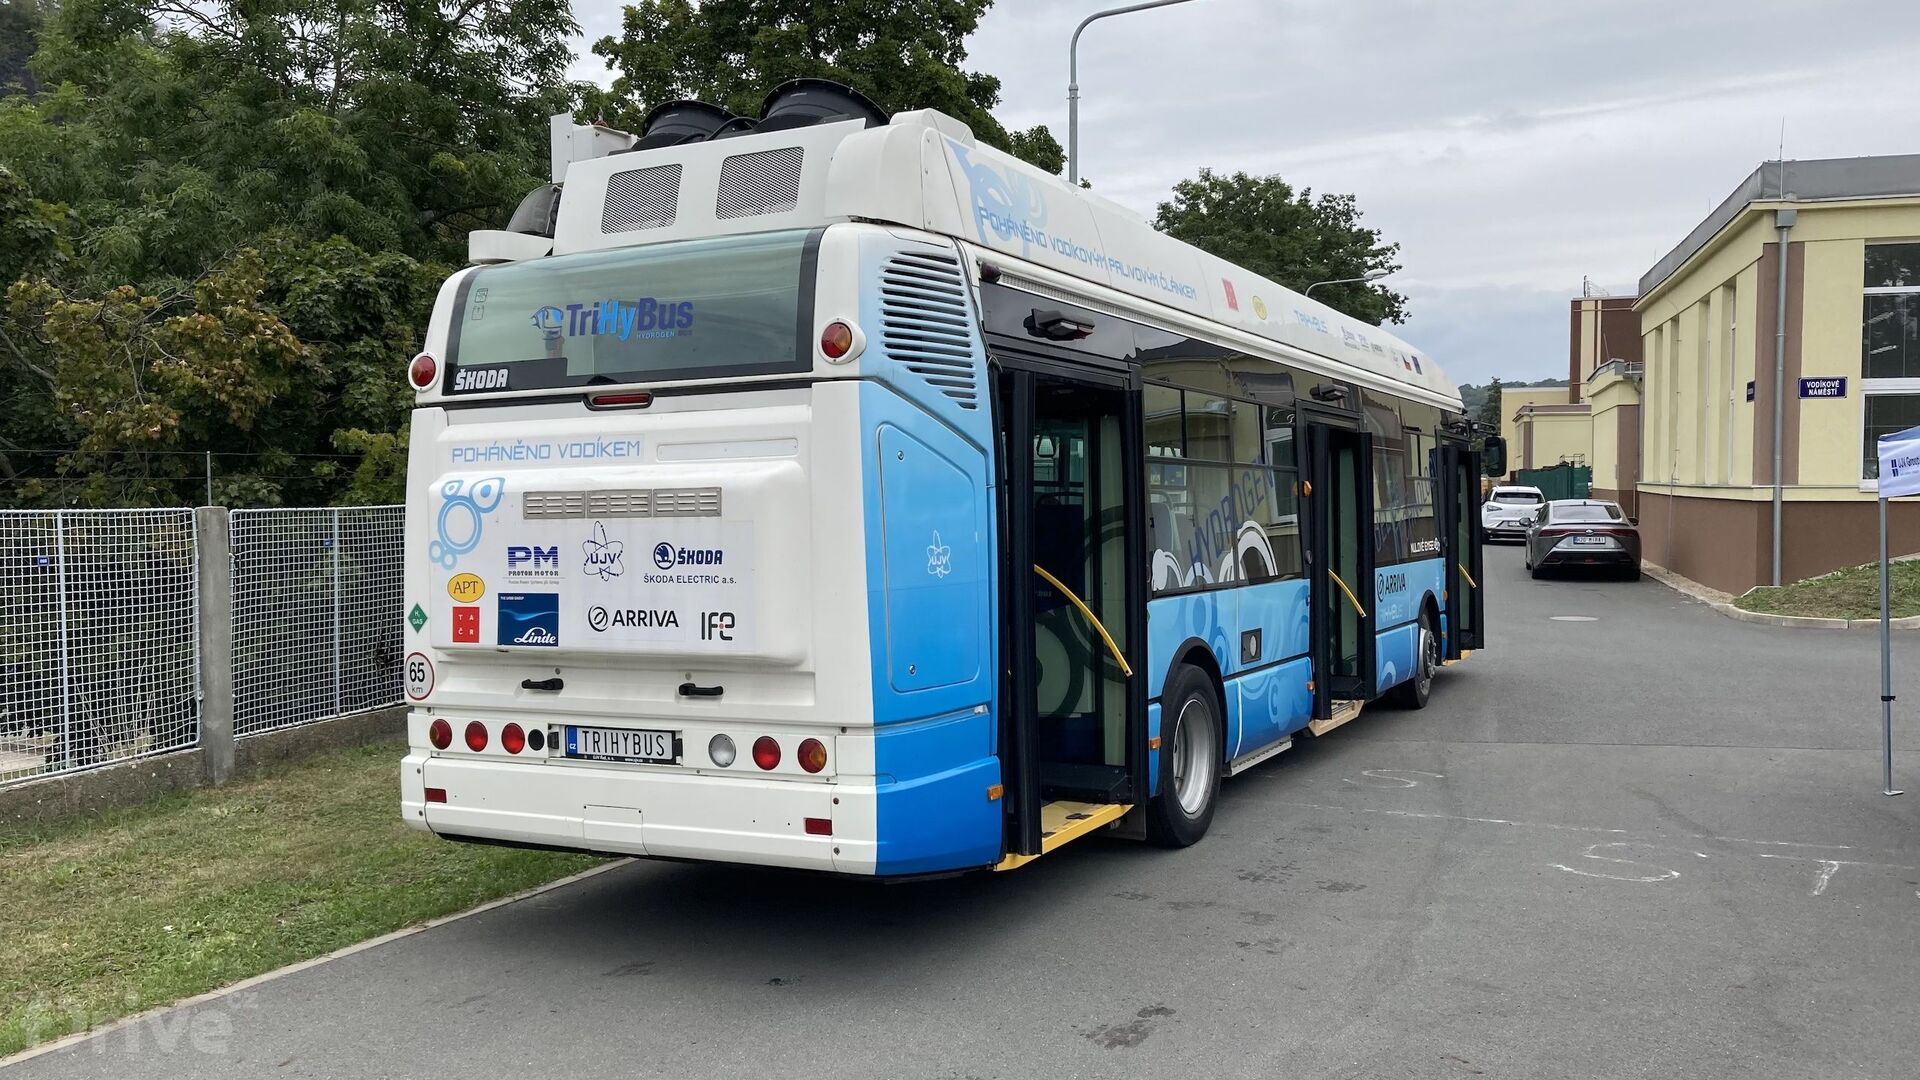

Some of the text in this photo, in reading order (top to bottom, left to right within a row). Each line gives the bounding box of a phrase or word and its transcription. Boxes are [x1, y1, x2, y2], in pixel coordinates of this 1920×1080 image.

[566, 297, 694, 342] TriHyBus
[636, 331, 675, 340] HYDROGEN
[453, 368, 509, 391] ŠKODA
[1806, 379, 1840, 388] VODÍKOVÉ
[1808, 387, 1838, 396] NÁMĚSTÍ
[452, 435, 641, 464] POHÁNĚNO VODÍKEM
[507, 546, 559, 569] PM
[677, 547, 723, 565] ŠKODA
[453, 580, 479, 594] APT
[643, 573, 737, 584] ŠKODA ELECTRIC a.s.
[612, 609, 679, 628] ARRIVA
[458, 627, 463, 635] Č
[513, 626, 557, 644] Linde
[409, 661, 426, 683] 65
[411, 685, 424, 694] km
[582, 730, 665, 757] TRIHYBUS
